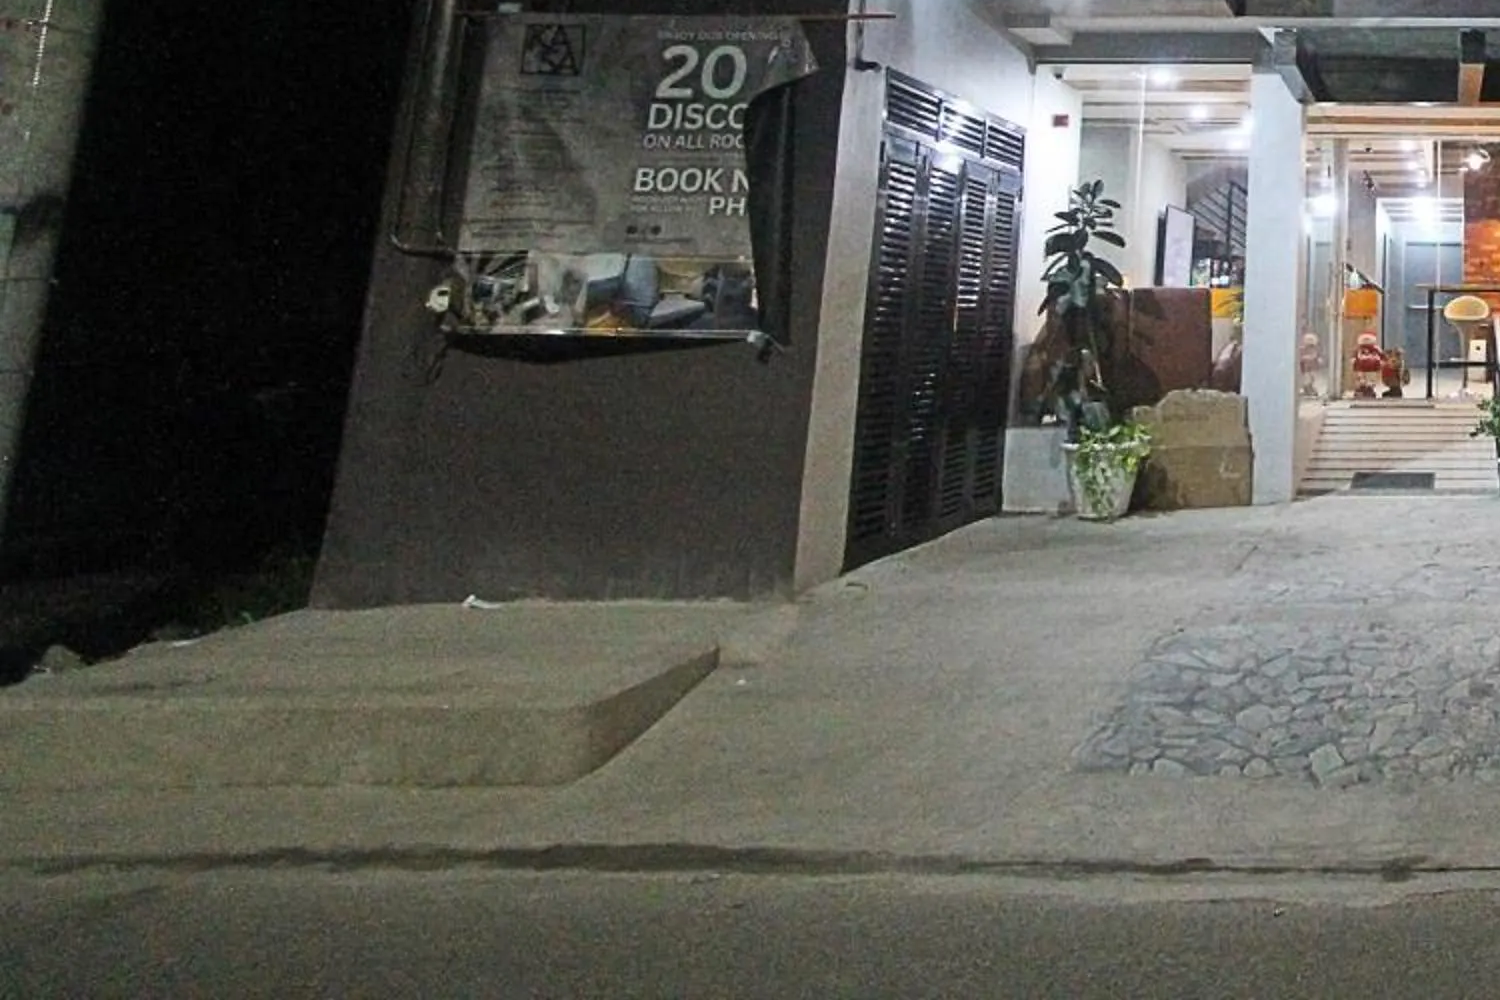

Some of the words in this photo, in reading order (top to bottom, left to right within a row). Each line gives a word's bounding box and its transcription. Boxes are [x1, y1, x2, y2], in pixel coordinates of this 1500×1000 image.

[655, 45, 748, 100] 20
[643, 133, 670, 150] ON
[673, 133, 704, 150] ALL
[634, 167, 724, 193] BOOK
